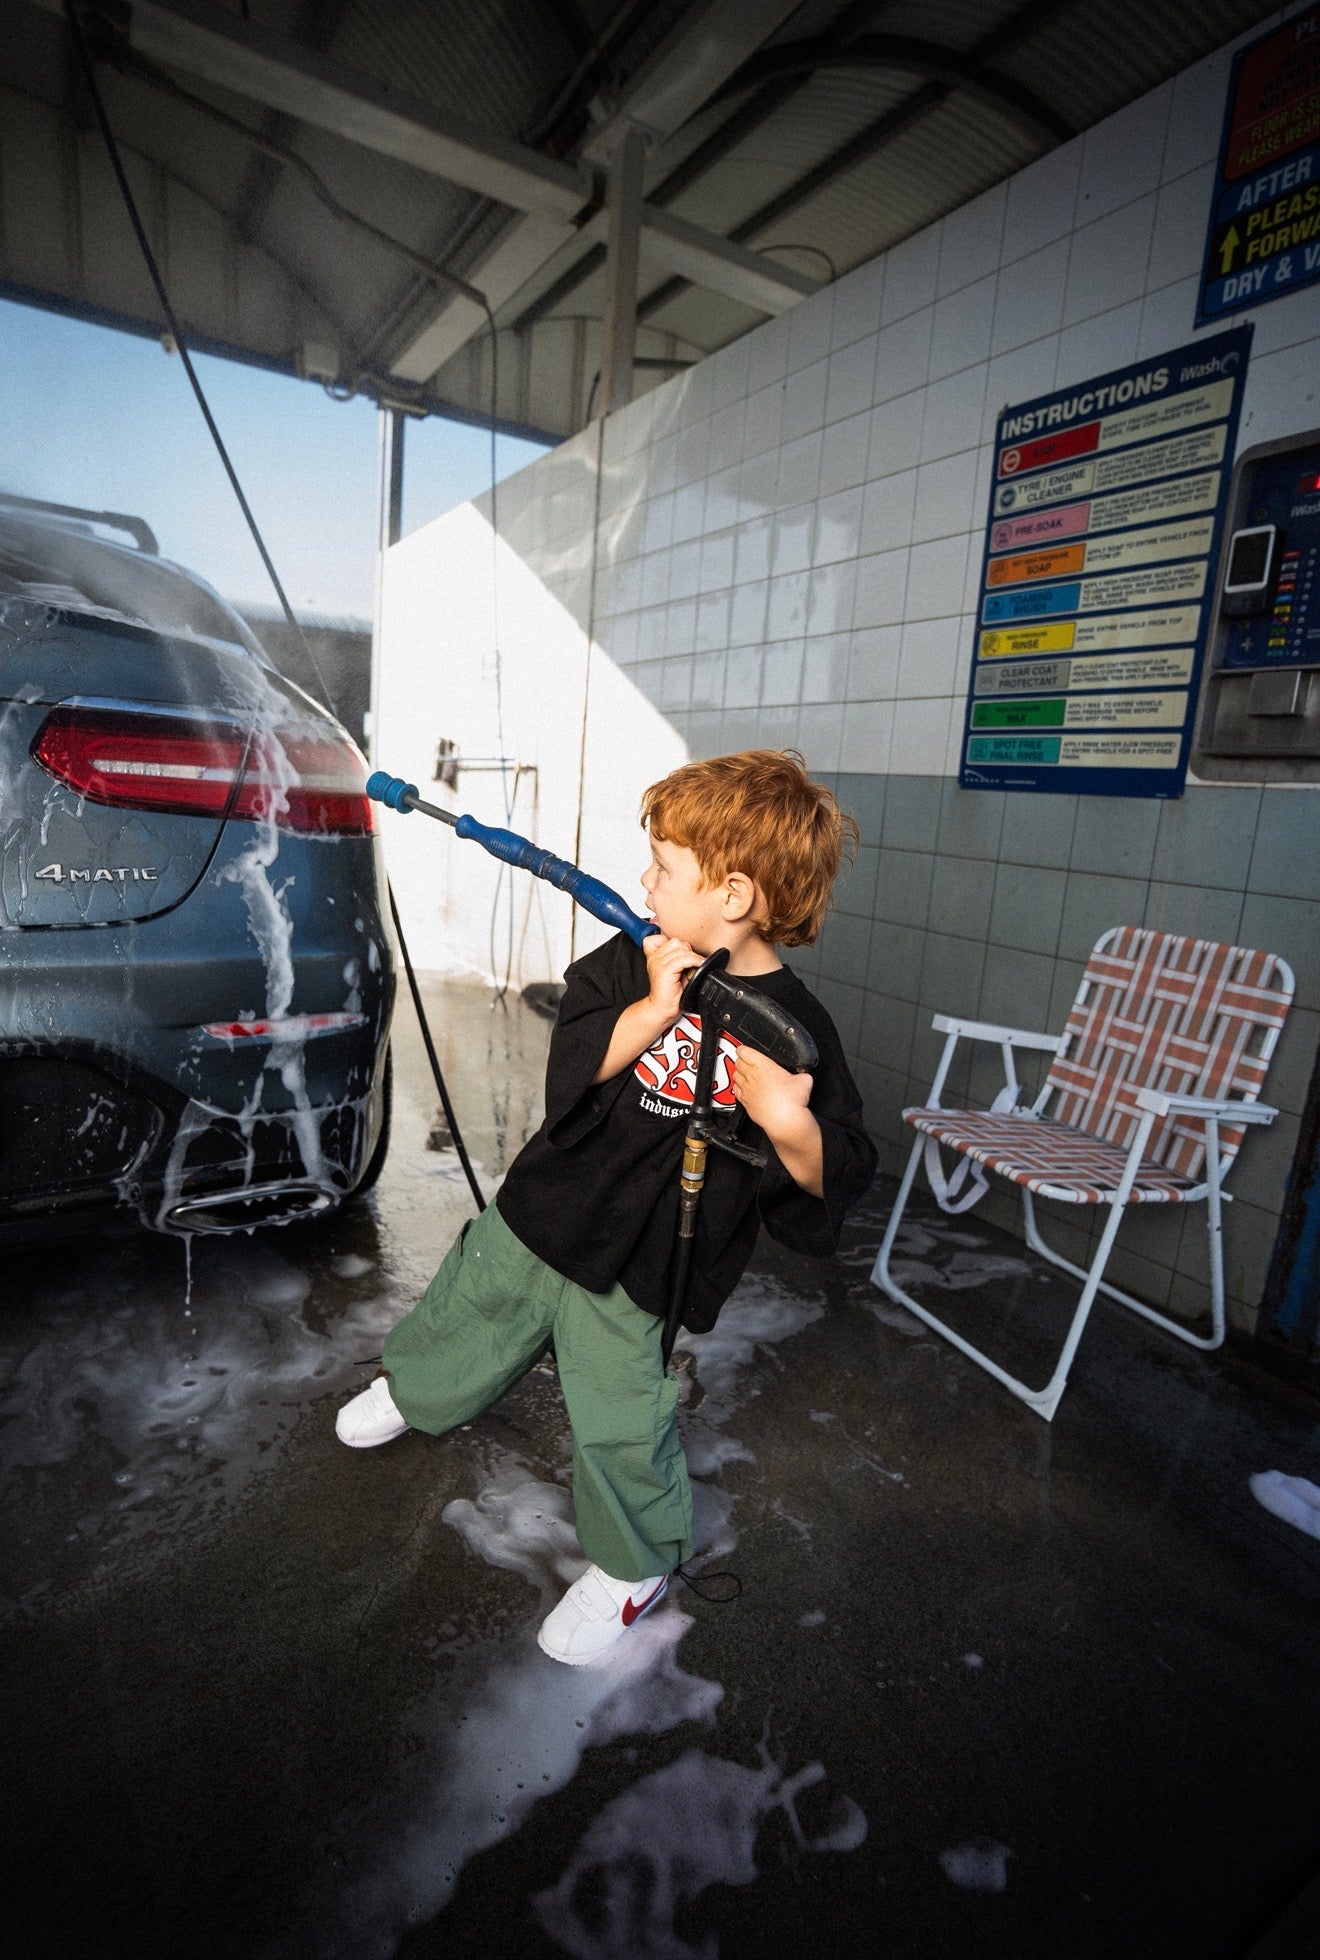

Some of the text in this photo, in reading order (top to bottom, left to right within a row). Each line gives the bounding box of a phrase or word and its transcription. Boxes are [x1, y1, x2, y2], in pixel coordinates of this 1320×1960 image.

[1238, 134, 1280, 168] PLEASE
[1237, 155, 1313, 211] AFTER
[1246, 185, 1320, 236] PLEAS
[1222, 265, 1268, 303] DRY
[1274, 255, 1293, 282] &
[1180, 356, 1221, 382] iWash
[1001, 367, 1169, 441] INSTRUCTIONS
[1018, 480, 1040, 494] TYRE
[1048, 468, 1086, 487] ENGINE
[1026, 483, 1073, 502] CLEANER
[1014, 518, 1062, 537] PRE-SOAK
[1026, 562, 1052, 575] SOAP
[1010, 640, 1040, 651] RINSE
[1000, 664, 1058, 678] CLEAR COAT
[998, 677, 1057, 689] PROTECTANT
[992, 740, 1043, 749] SPOT FREE
[35, 863, 158, 882] 4MATIC
